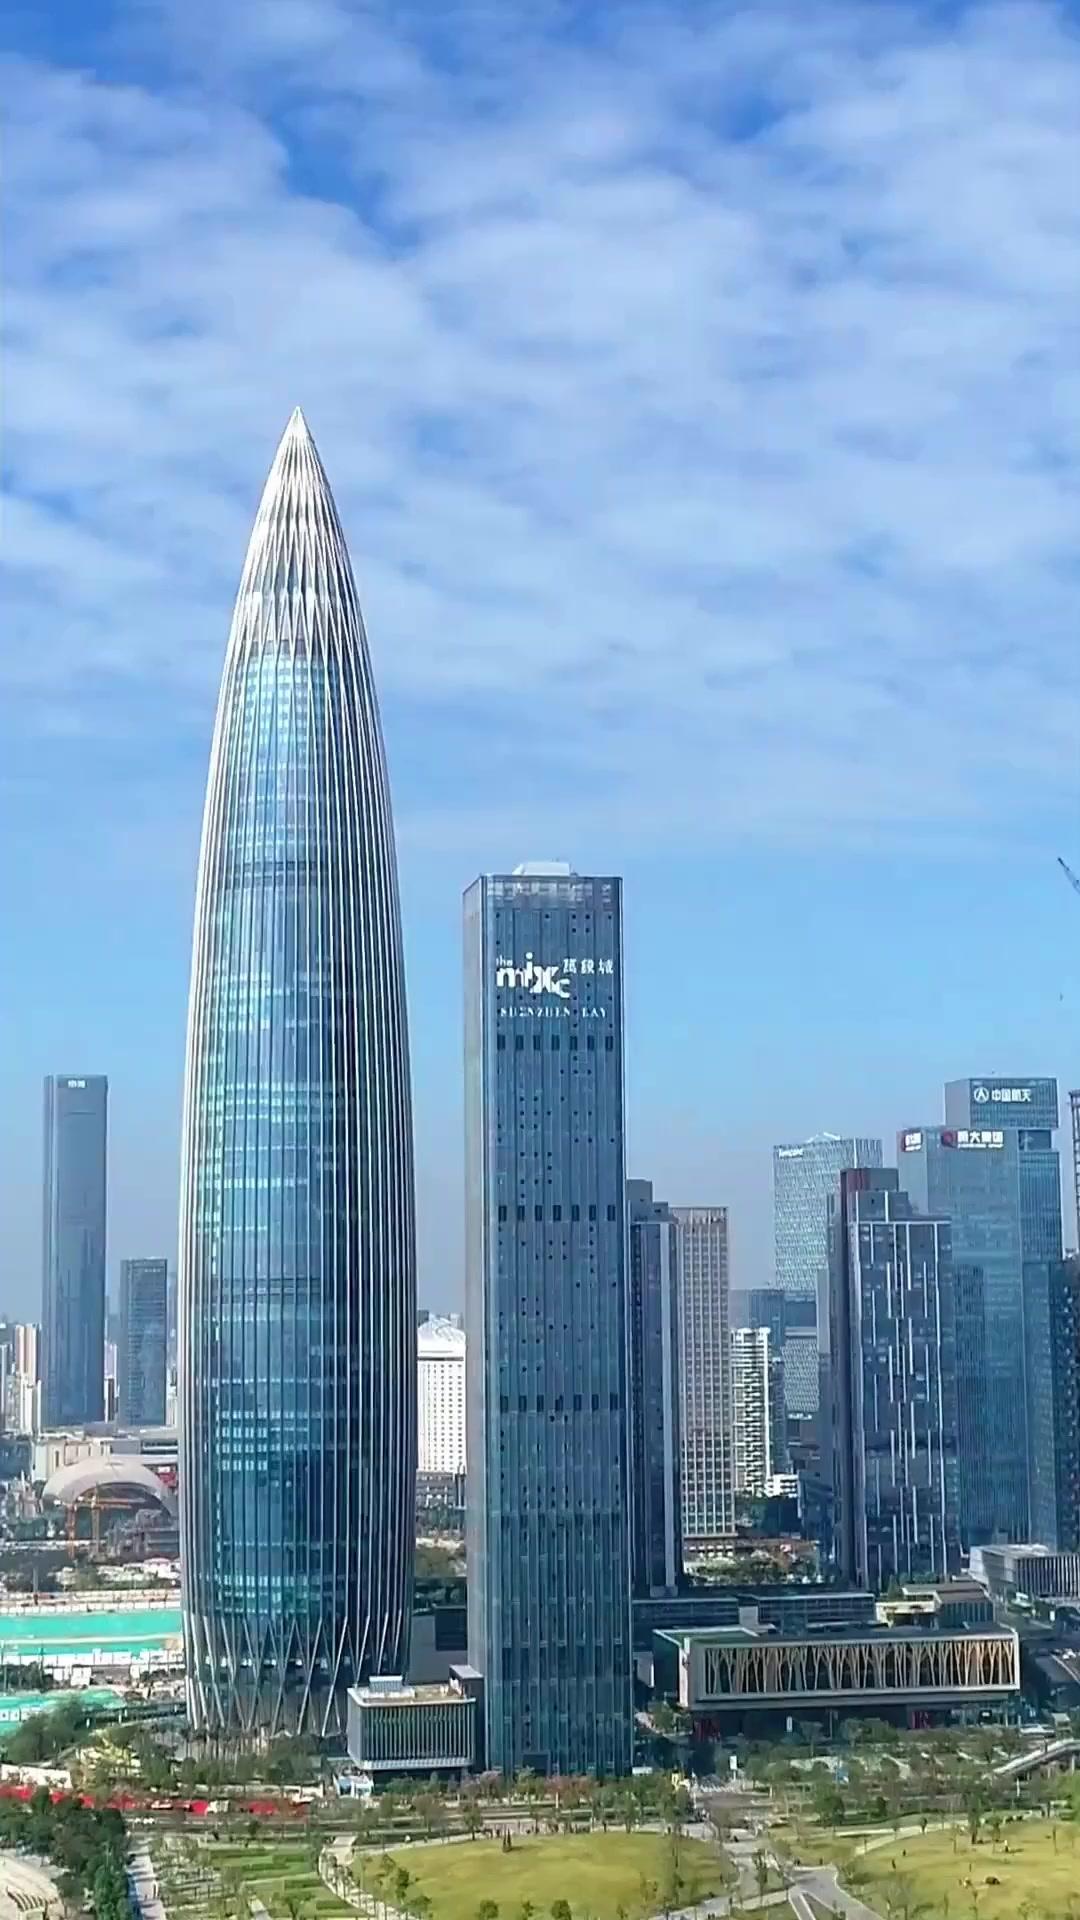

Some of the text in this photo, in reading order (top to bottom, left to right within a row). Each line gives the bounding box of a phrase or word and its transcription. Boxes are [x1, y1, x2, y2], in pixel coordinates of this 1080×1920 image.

[496, 954, 513, 966] the
[991, 1088, 1032, 1103] 中国航天
